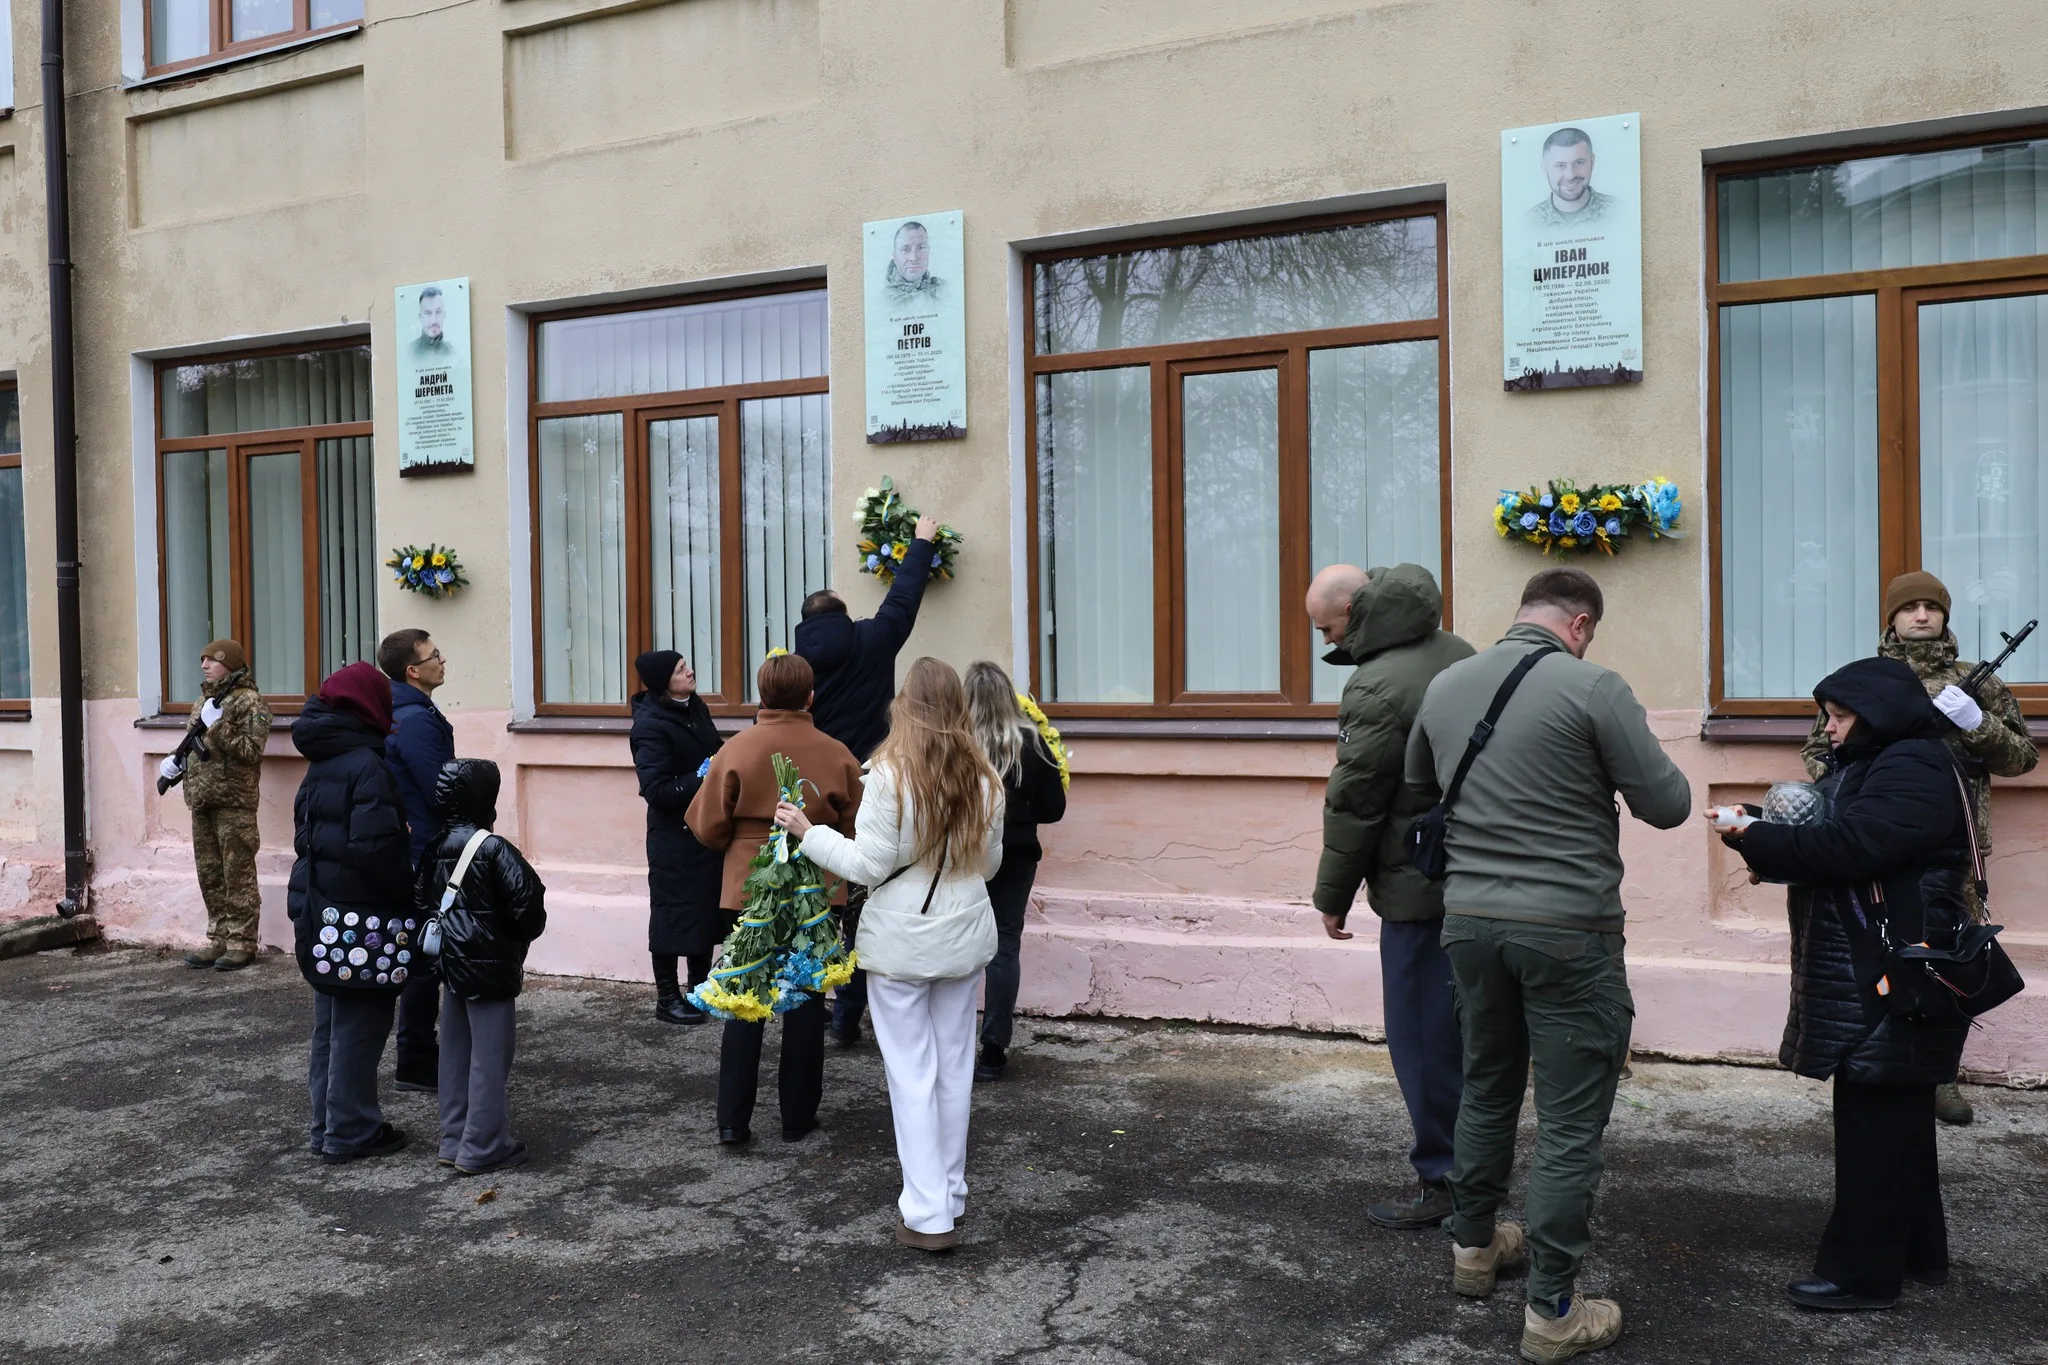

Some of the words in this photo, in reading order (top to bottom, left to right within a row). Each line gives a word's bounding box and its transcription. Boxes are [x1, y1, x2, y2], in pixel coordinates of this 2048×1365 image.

[1555, 248, 1586, 263] ІВАН
[1534, 262, 1609, 283] ЦИПЕРДЮК
[904, 323, 924, 336] ІГОР
[898, 337, 931, 350] ПЕТРІВ
[420, 371, 447, 385] АНДРІЙ
[415, 385, 453, 398] ШЕРЕМЕТА
